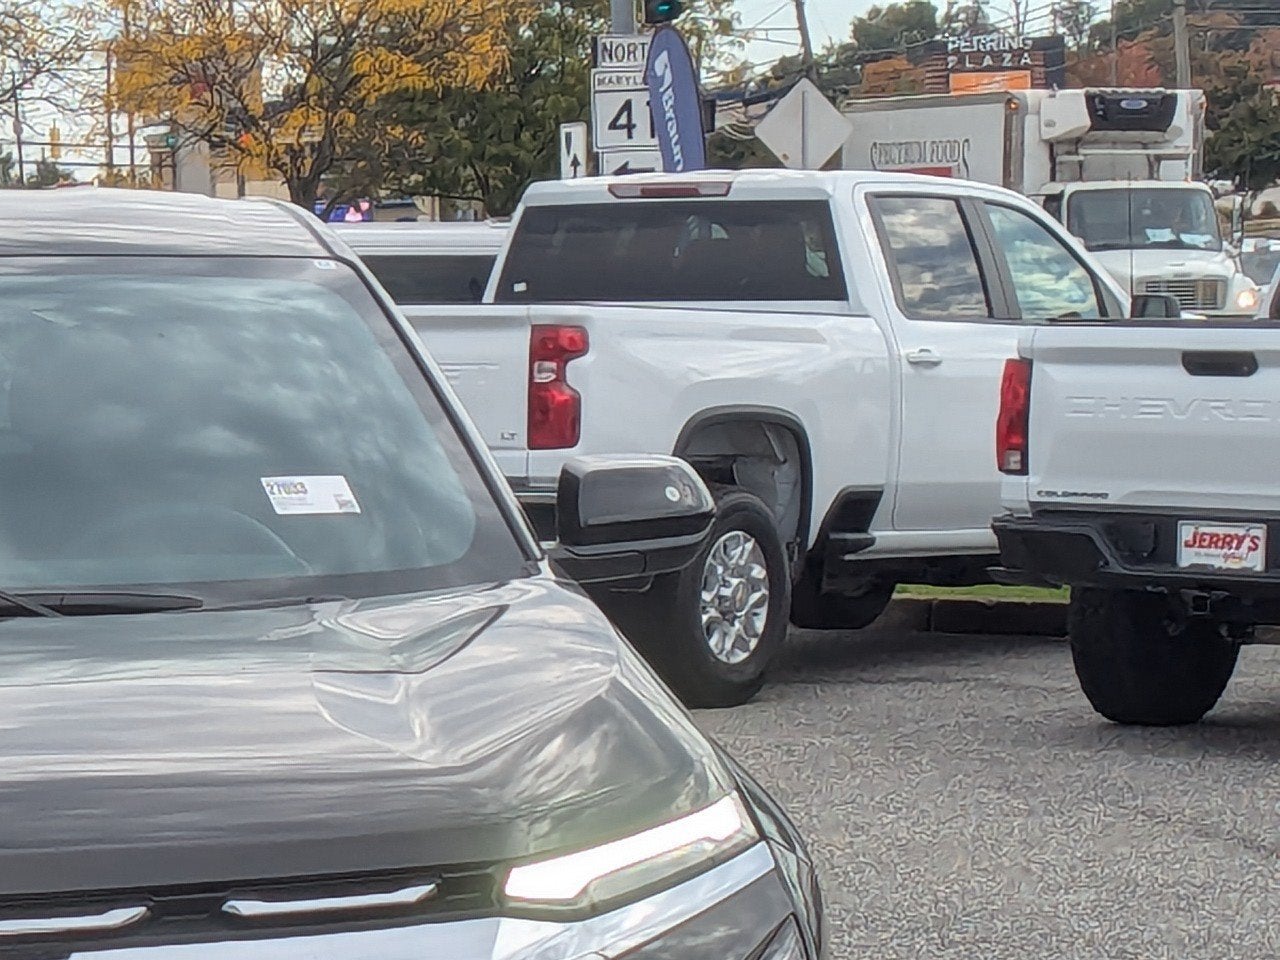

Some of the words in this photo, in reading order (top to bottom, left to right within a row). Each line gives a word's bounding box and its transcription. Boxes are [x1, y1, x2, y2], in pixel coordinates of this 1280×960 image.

[601, 41, 648, 62] NORT
[946, 53, 1032, 69] PLAZA
[597, 75, 637, 86] MARYL
[1064, 396, 1280, 422] CHEVRO
[1184, 531, 1262, 552] JERRY'S
